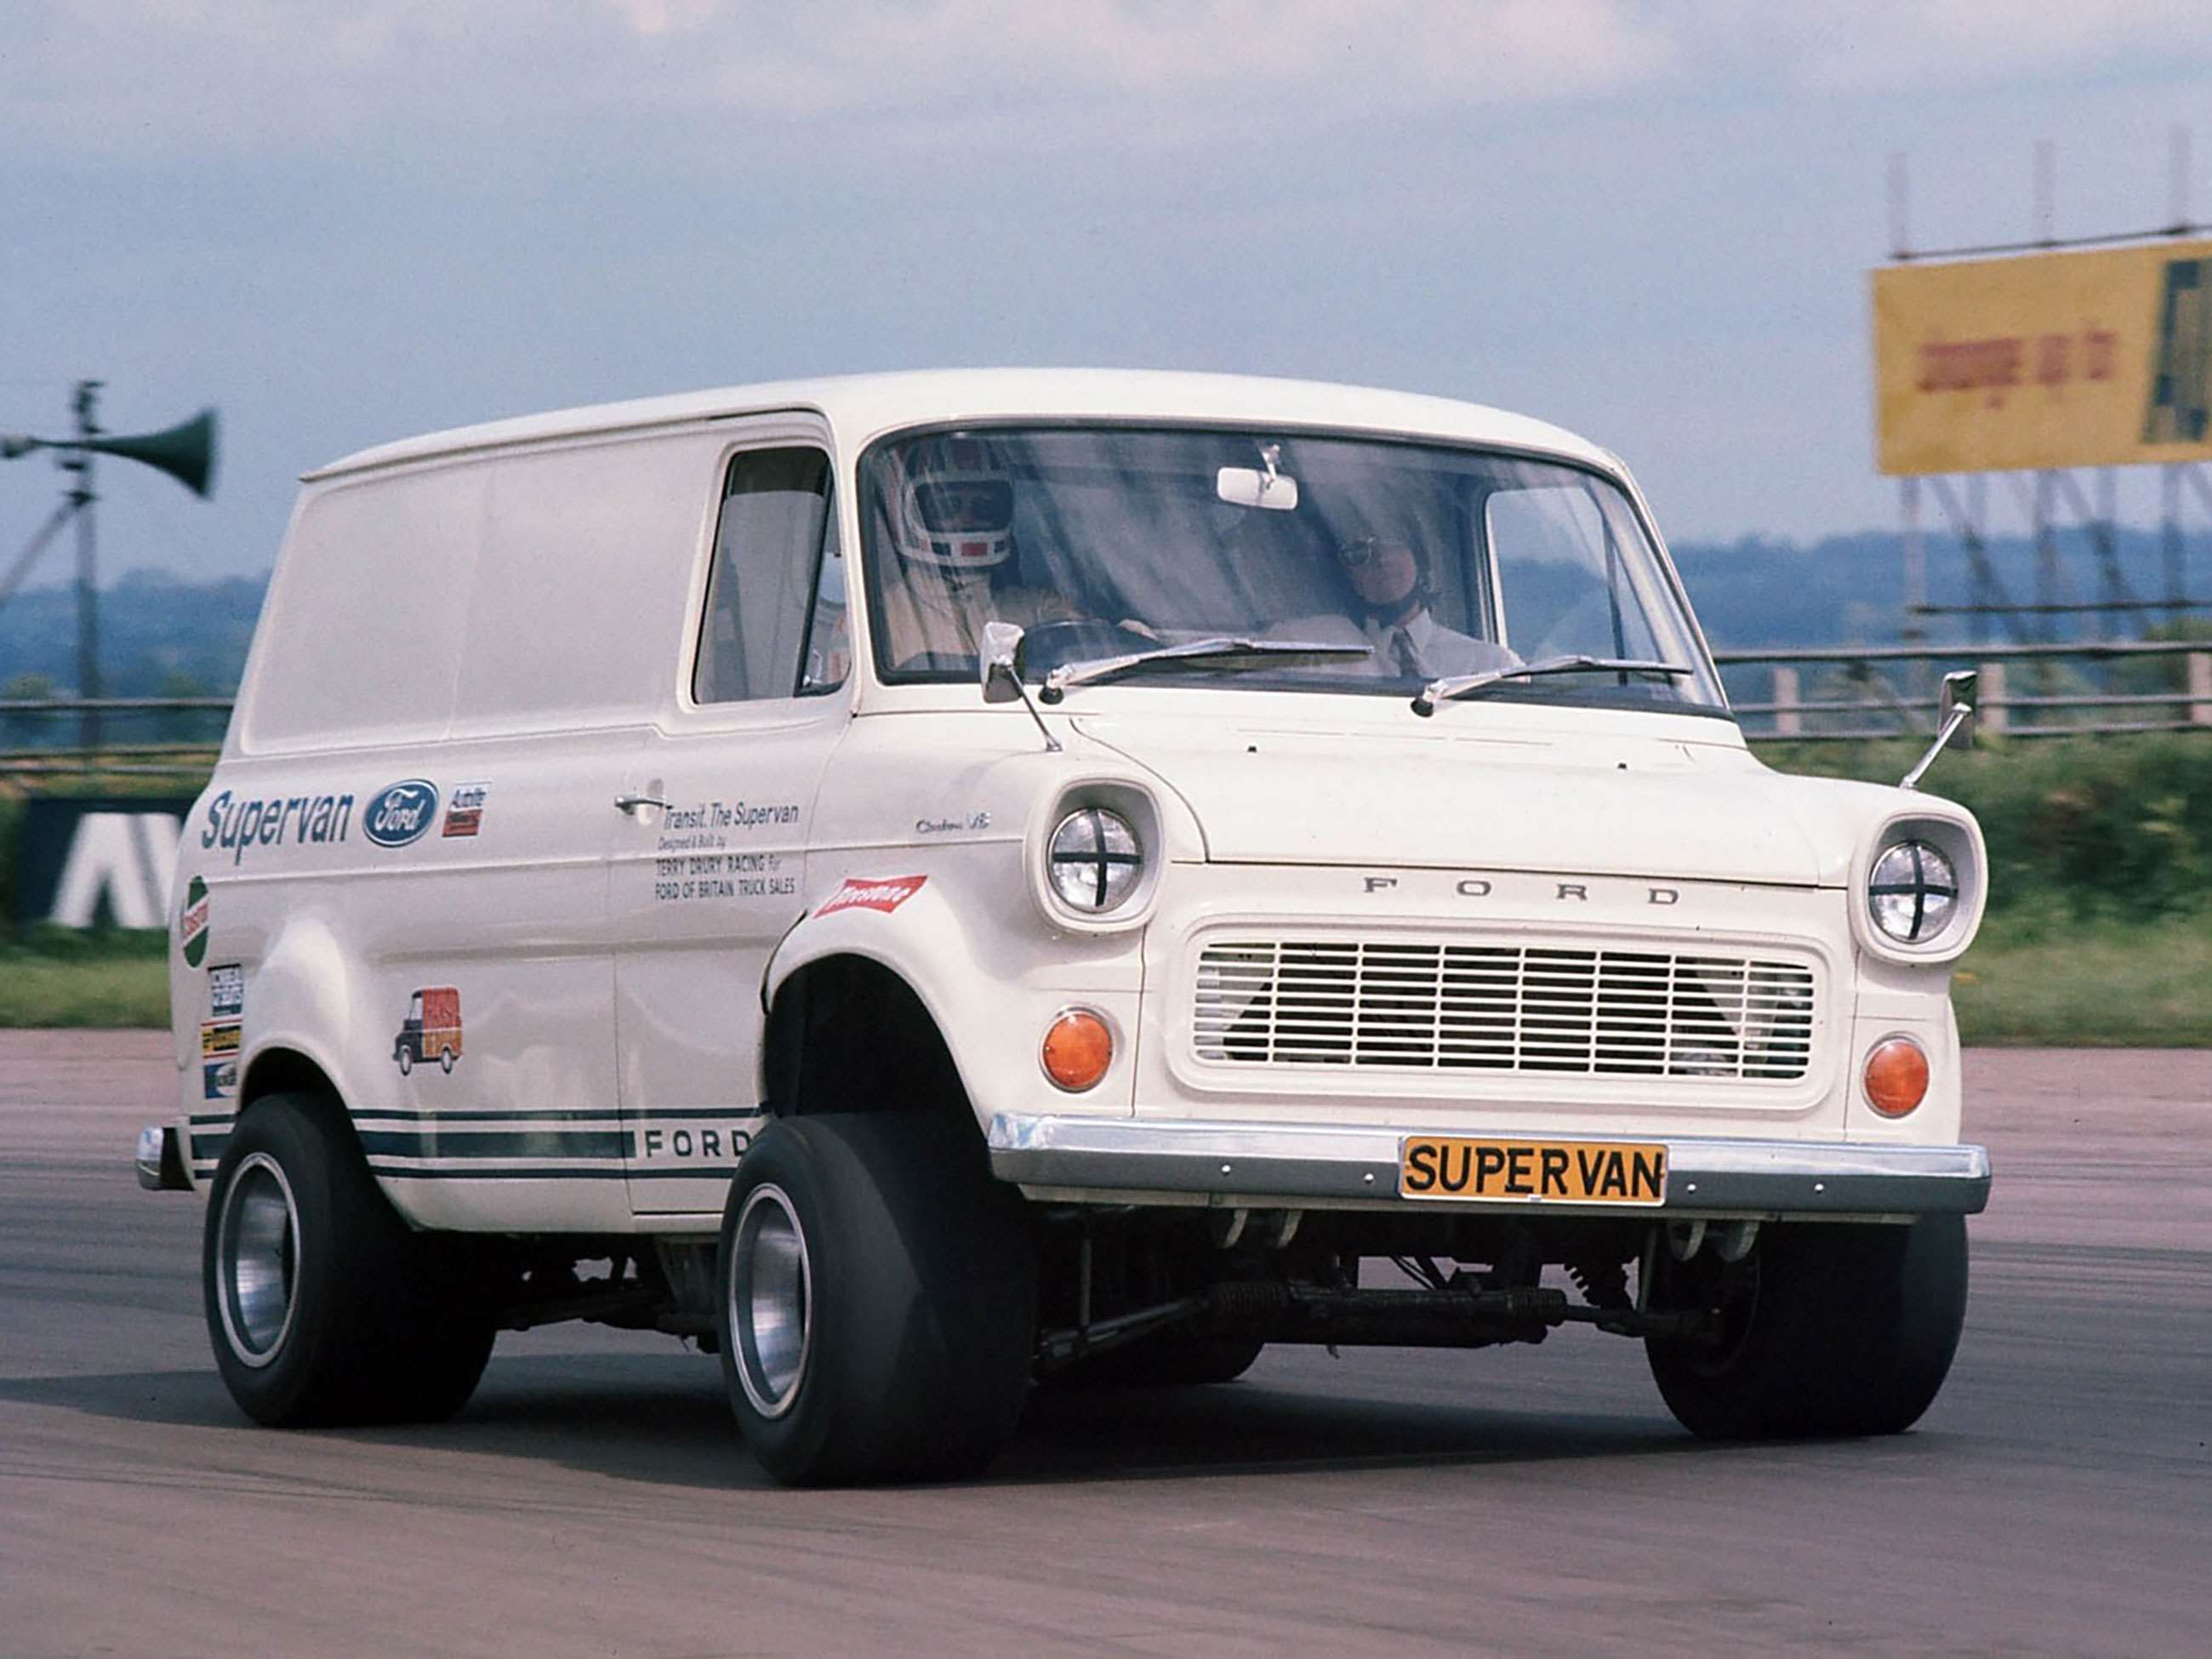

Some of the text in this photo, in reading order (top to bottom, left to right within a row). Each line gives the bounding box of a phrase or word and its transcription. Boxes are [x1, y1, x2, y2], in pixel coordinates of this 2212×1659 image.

[374, 788, 425, 831] Ford
[711, 802, 732, 827] The
[734, 801, 799, 830] Supervan
[202, 790, 354, 866] Supervan
[656, 858, 685, 876] TERRY
[690, 856, 722, 875] DRURY
[727, 854, 765, 873] RACING
[654, 877, 795, 900] FORD OF BRITAIN TRUCK SALES
[1363, 876, 1679, 906] FORD
[645, 1129, 751, 1158] FORD
[1405, 1144, 1663, 1198] SUPERVAN
